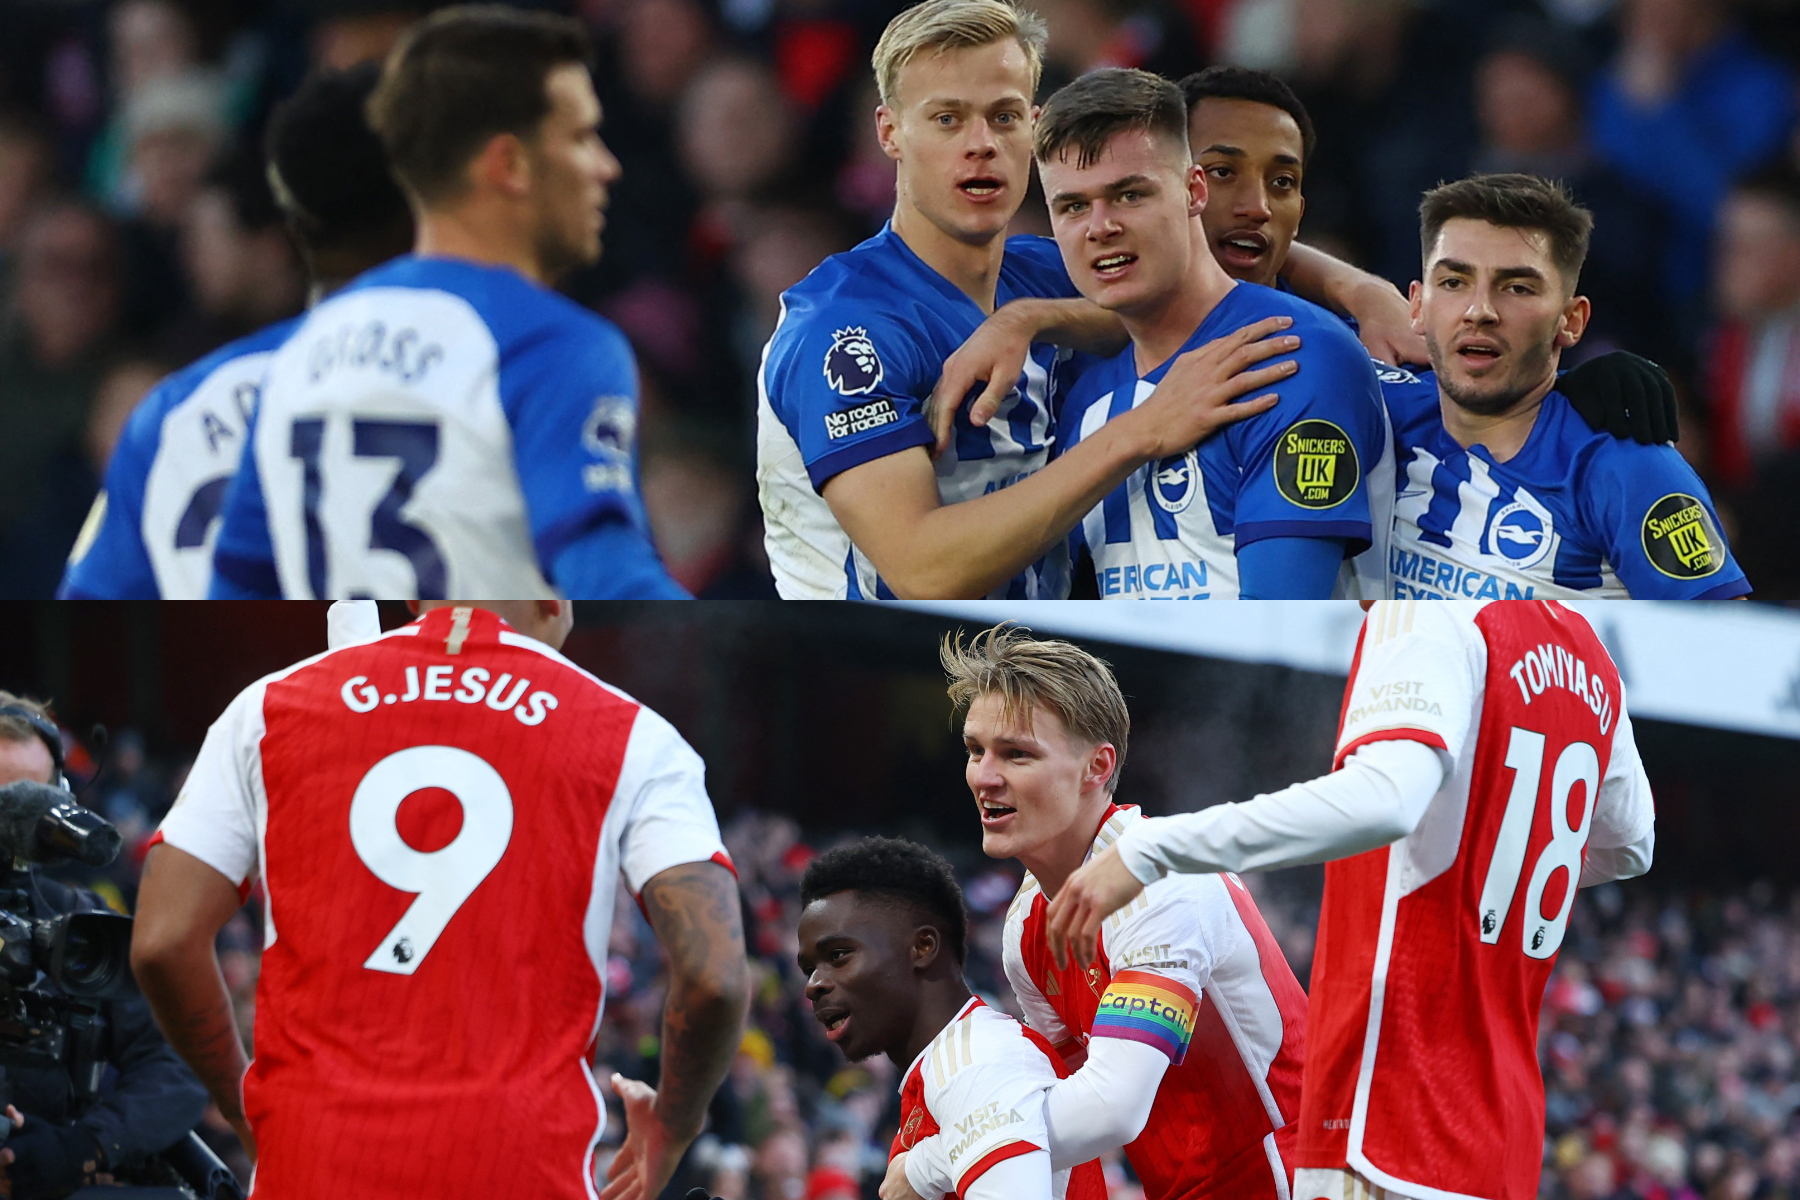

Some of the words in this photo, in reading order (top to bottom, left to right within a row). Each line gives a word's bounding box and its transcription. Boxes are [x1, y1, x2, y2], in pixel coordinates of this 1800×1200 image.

[824, 412, 848, 428] No
[848, 400, 890, 421] room
[828, 424, 849, 440] for
[850, 410, 899, 433] racism
[1301, 457, 1331, 483] UK
[290, 417, 448, 600] 13
[1304, 487, 1329, 500] .COM
[1673, 526, 1706, 557] UK
[1097, 560, 1208, 598] ERICAN
[341, 665, 558, 727] G.JESUS
[1370, 681, 1424, 700] VISIT
[1509, 643, 1612, 736] TOMIYASU
[1349, 697, 1443, 726] RWANDA
[1478, 725, 1600, 961] 18
[349, 745, 514, 975] 9
[1122, 944, 1171, 968] VISIT
[954, 1101, 999, 1135] VISIT
[949, 1108, 1025, 1165] RWANDA
